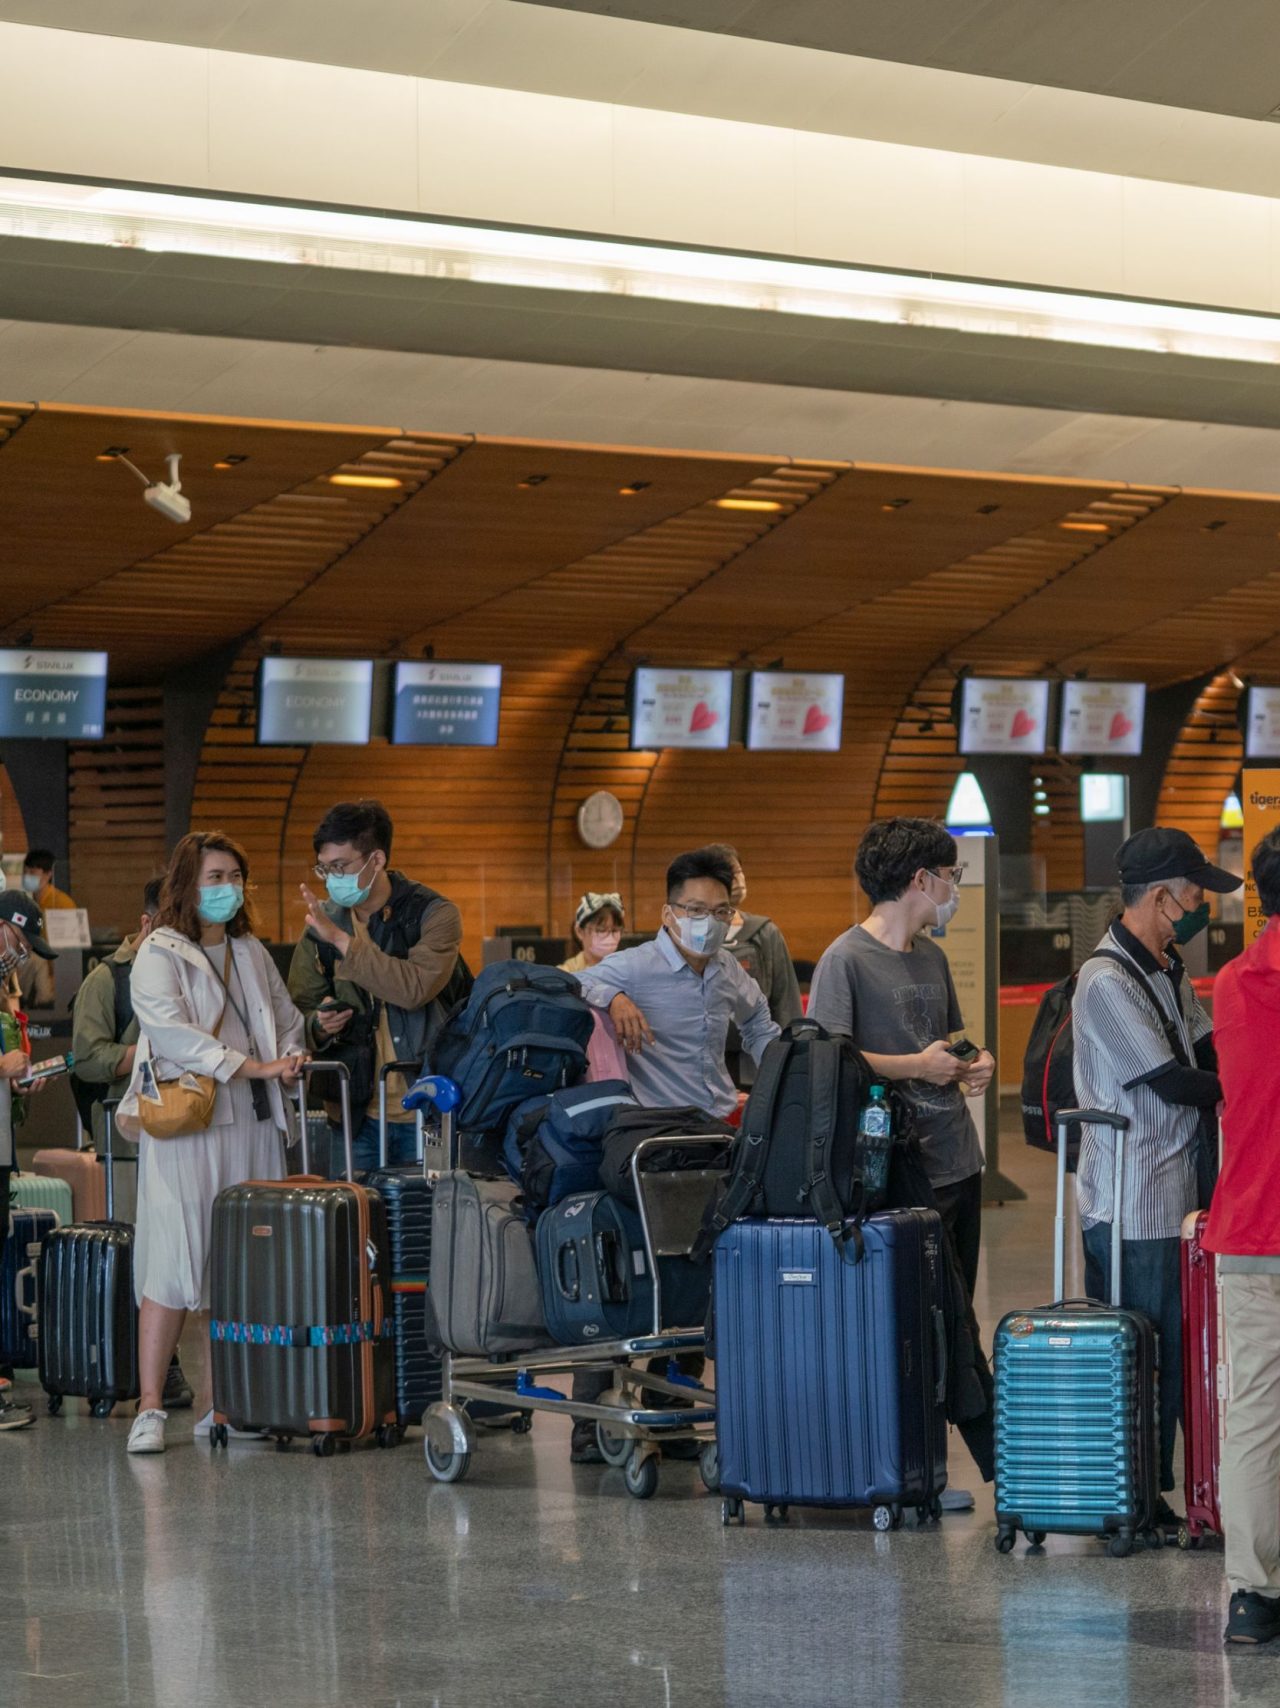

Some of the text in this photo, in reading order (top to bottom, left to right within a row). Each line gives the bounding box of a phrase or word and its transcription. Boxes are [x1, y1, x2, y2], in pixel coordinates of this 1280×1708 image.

[14, 688, 80, 703] ECONOMY
[1053, 933, 1071, 949] 09
[515, 946, 536, 962] 06
